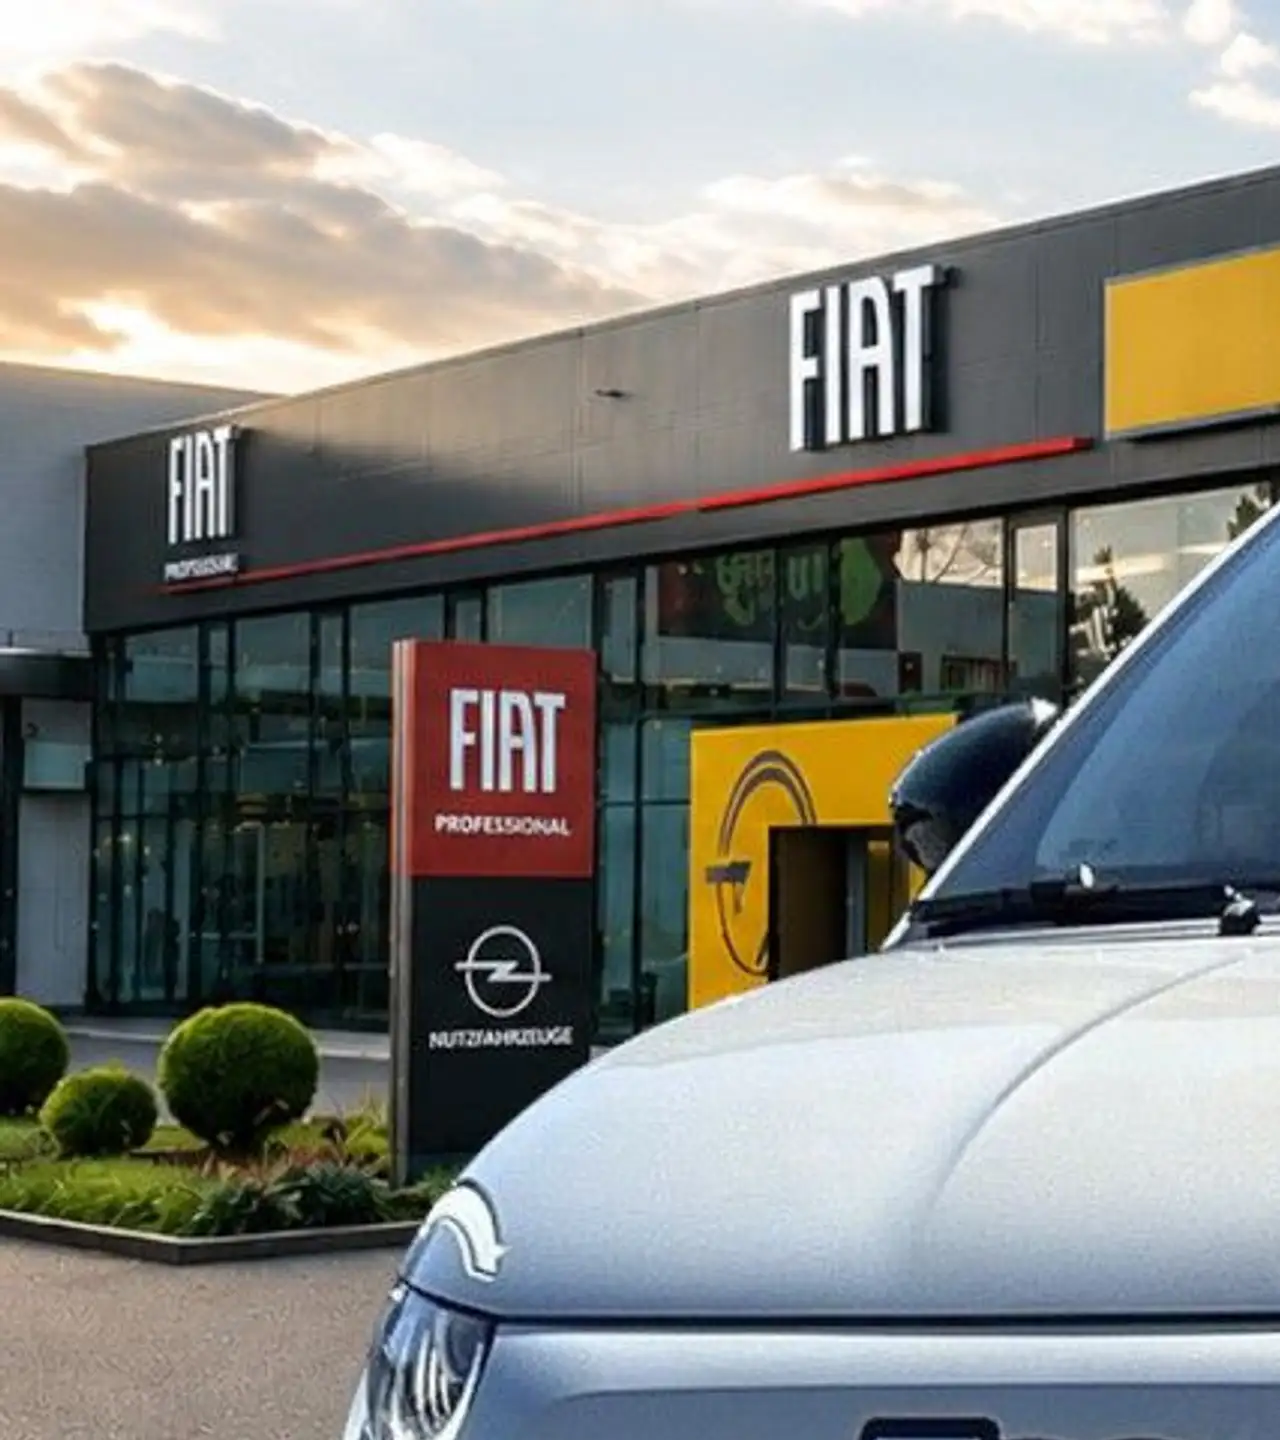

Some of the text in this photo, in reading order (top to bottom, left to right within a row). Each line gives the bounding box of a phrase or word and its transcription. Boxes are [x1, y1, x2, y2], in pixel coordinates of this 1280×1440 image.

[789, 264, 938, 451] FIAT
[168, 425, 237, 545] FIAT
[450, 688, 567, 794] FIAT
[434, 813, 571, 837] PROFESSIONAL
[428, 1026, 574, 1049] NUTZFAHRZEUGE
